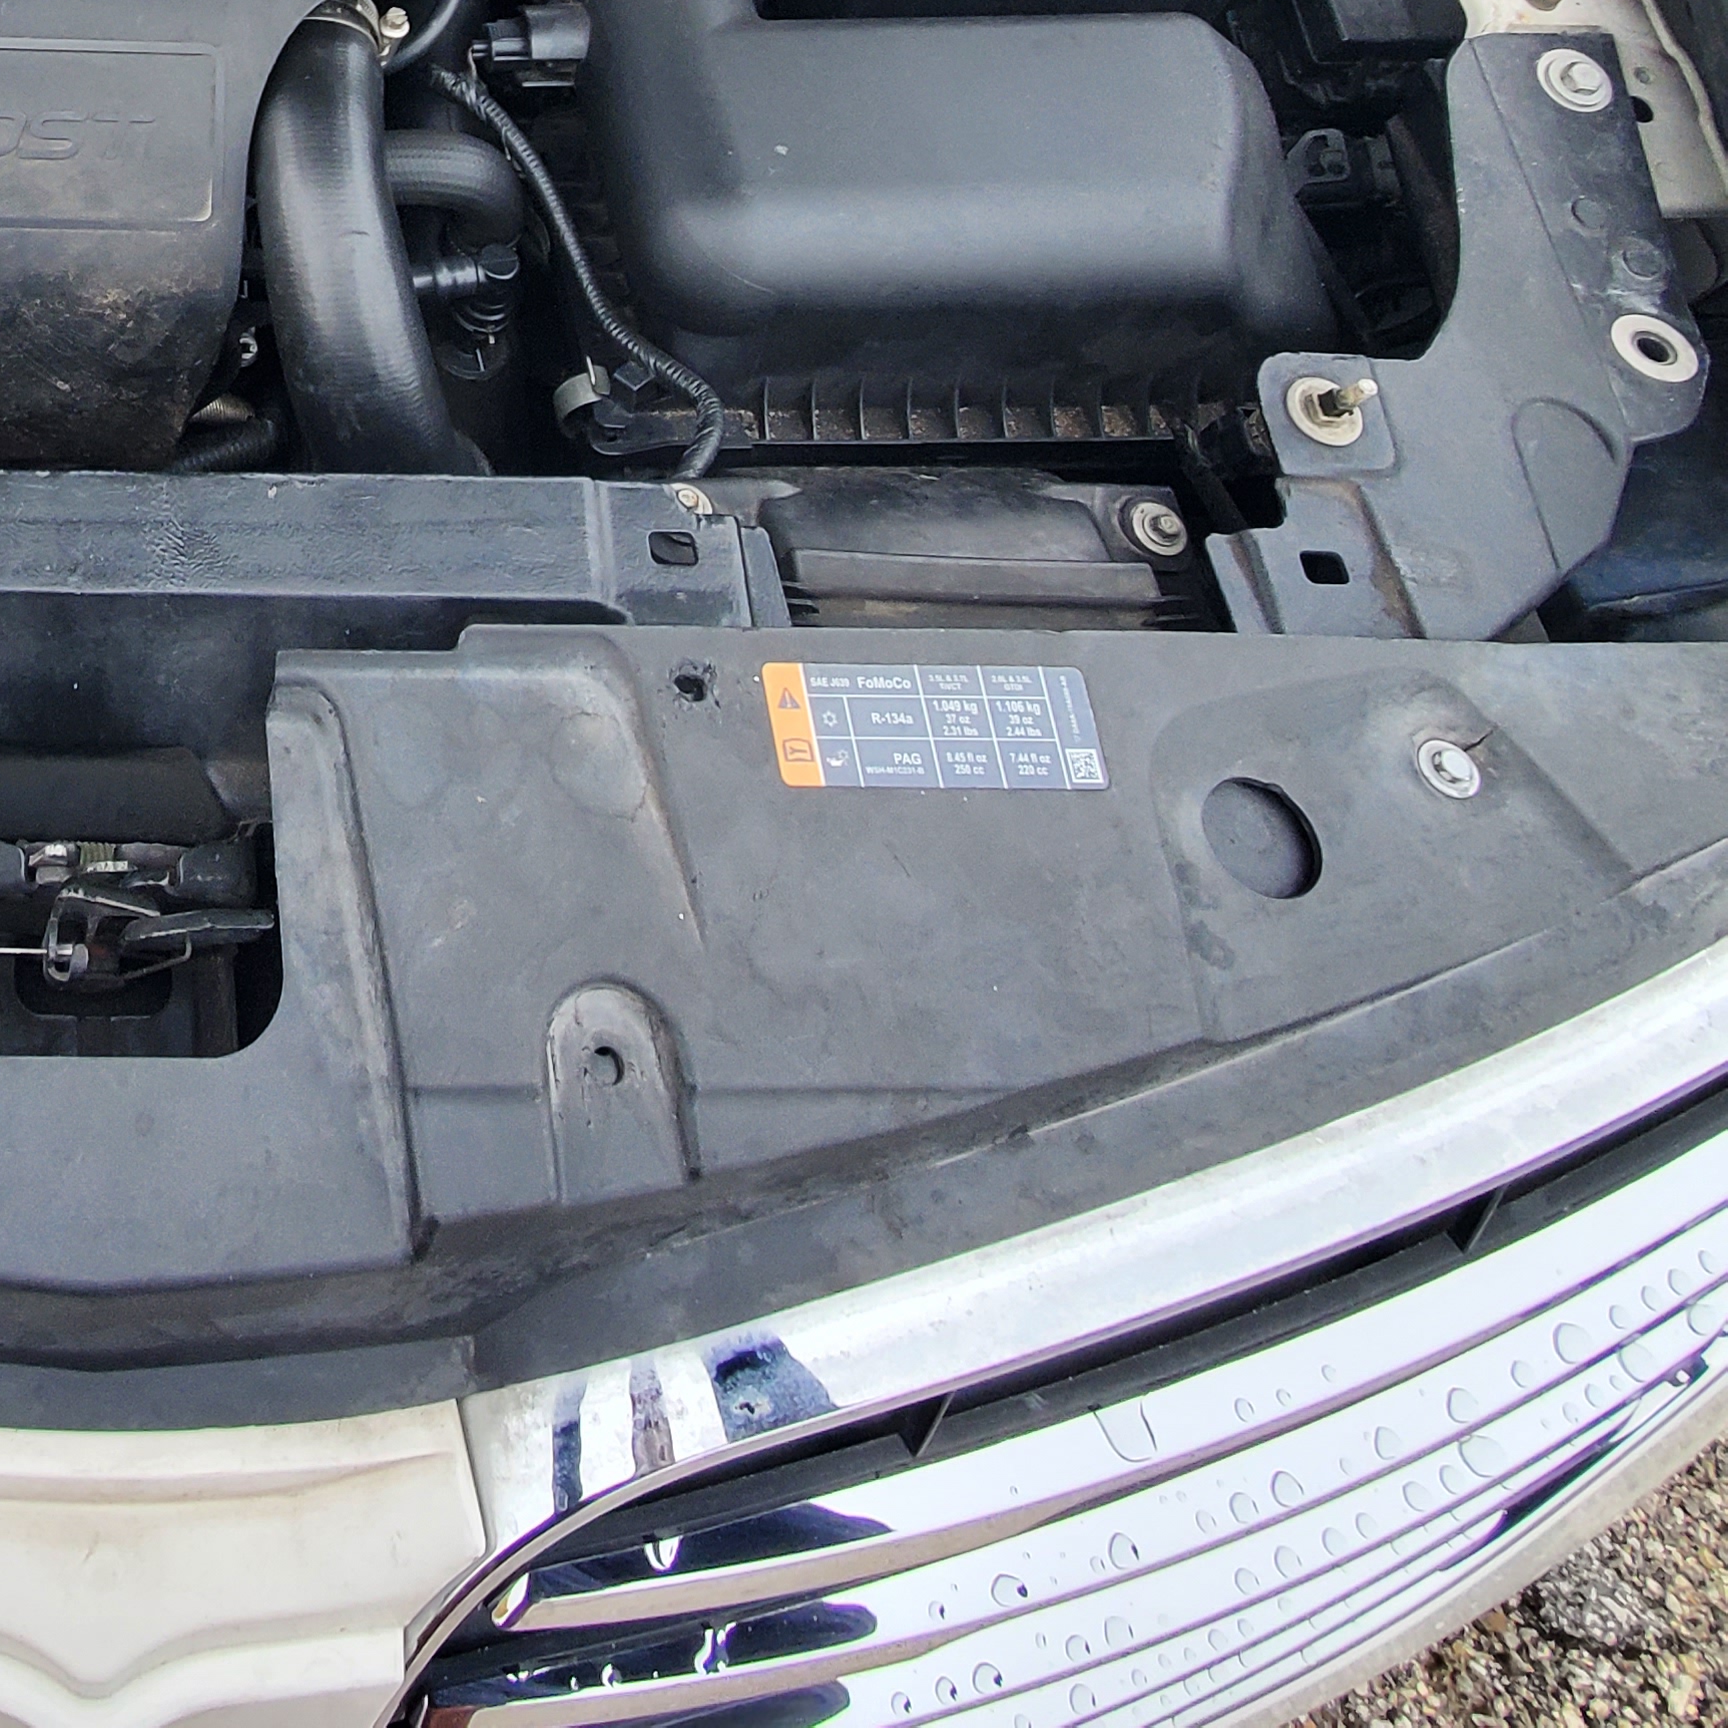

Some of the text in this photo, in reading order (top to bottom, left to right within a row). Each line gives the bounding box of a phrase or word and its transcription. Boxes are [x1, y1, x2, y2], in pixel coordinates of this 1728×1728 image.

[810, 676, 829, 687] SAE
[856, 675, 912, 690] FoMoCo
[932, 699, 979, 715] 1.049 kg
[995, 700, 1042, 716] 1.106 kg
[870, 712, 914, 725] R-134a
[945, 713, 972, 725] 37 oz
[1008, 714, 1035, 726] 39 oz
[962, 725, 980, 737] lbs
[1005, 726, 1043, 738] 2.44 lbs
[893, 752, 922, 765] PAG
[975, 754, 988, 764] oz
[1038, 755, 1052, 764] oz
[954, 763, 986, 775] 250 cc
[1017, 764, 1049, 776] 220 cc
